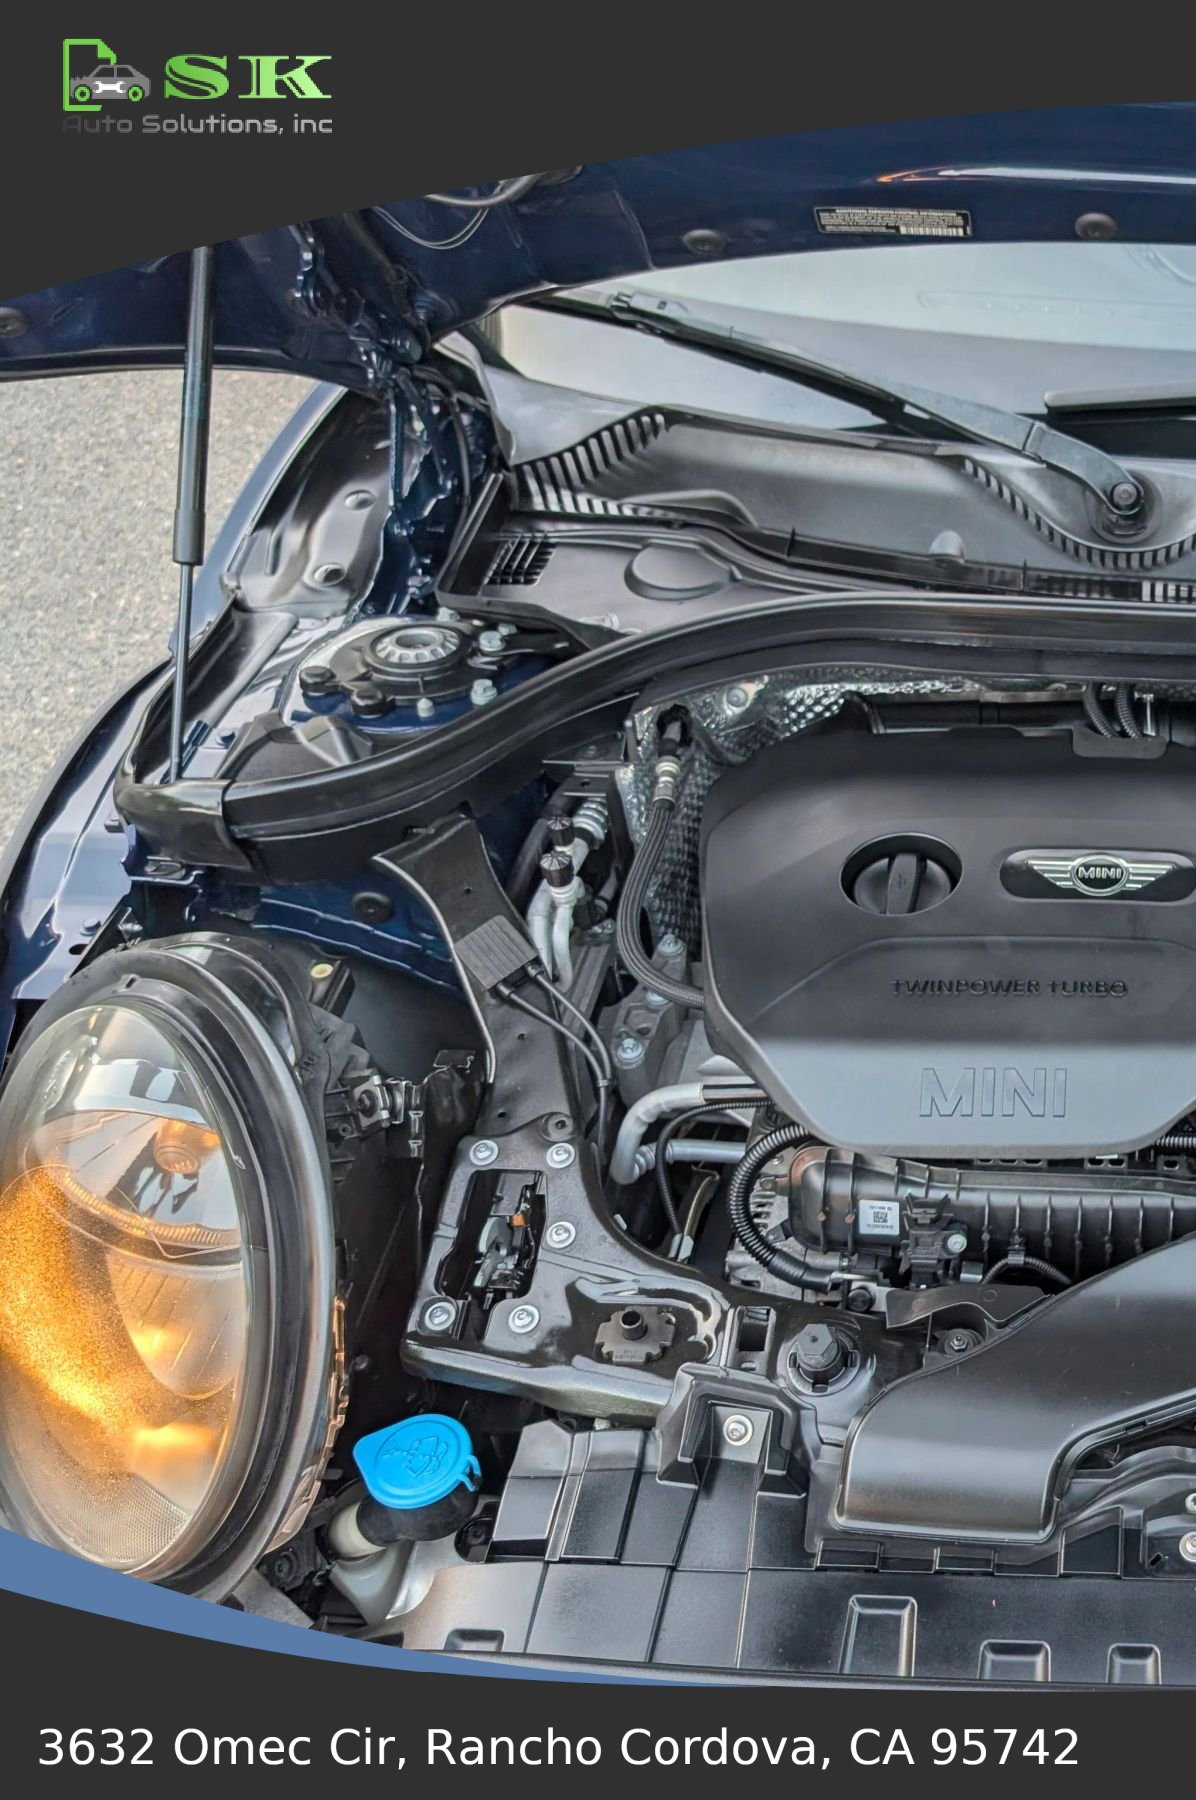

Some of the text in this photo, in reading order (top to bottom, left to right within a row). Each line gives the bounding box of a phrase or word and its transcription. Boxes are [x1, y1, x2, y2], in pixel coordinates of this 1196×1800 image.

[1077, 866, 1122, 880] MINI
[891, 979, 1129, 998] TWINPOWER TURBO
[919, 1067, 1068, 1118] MINI
